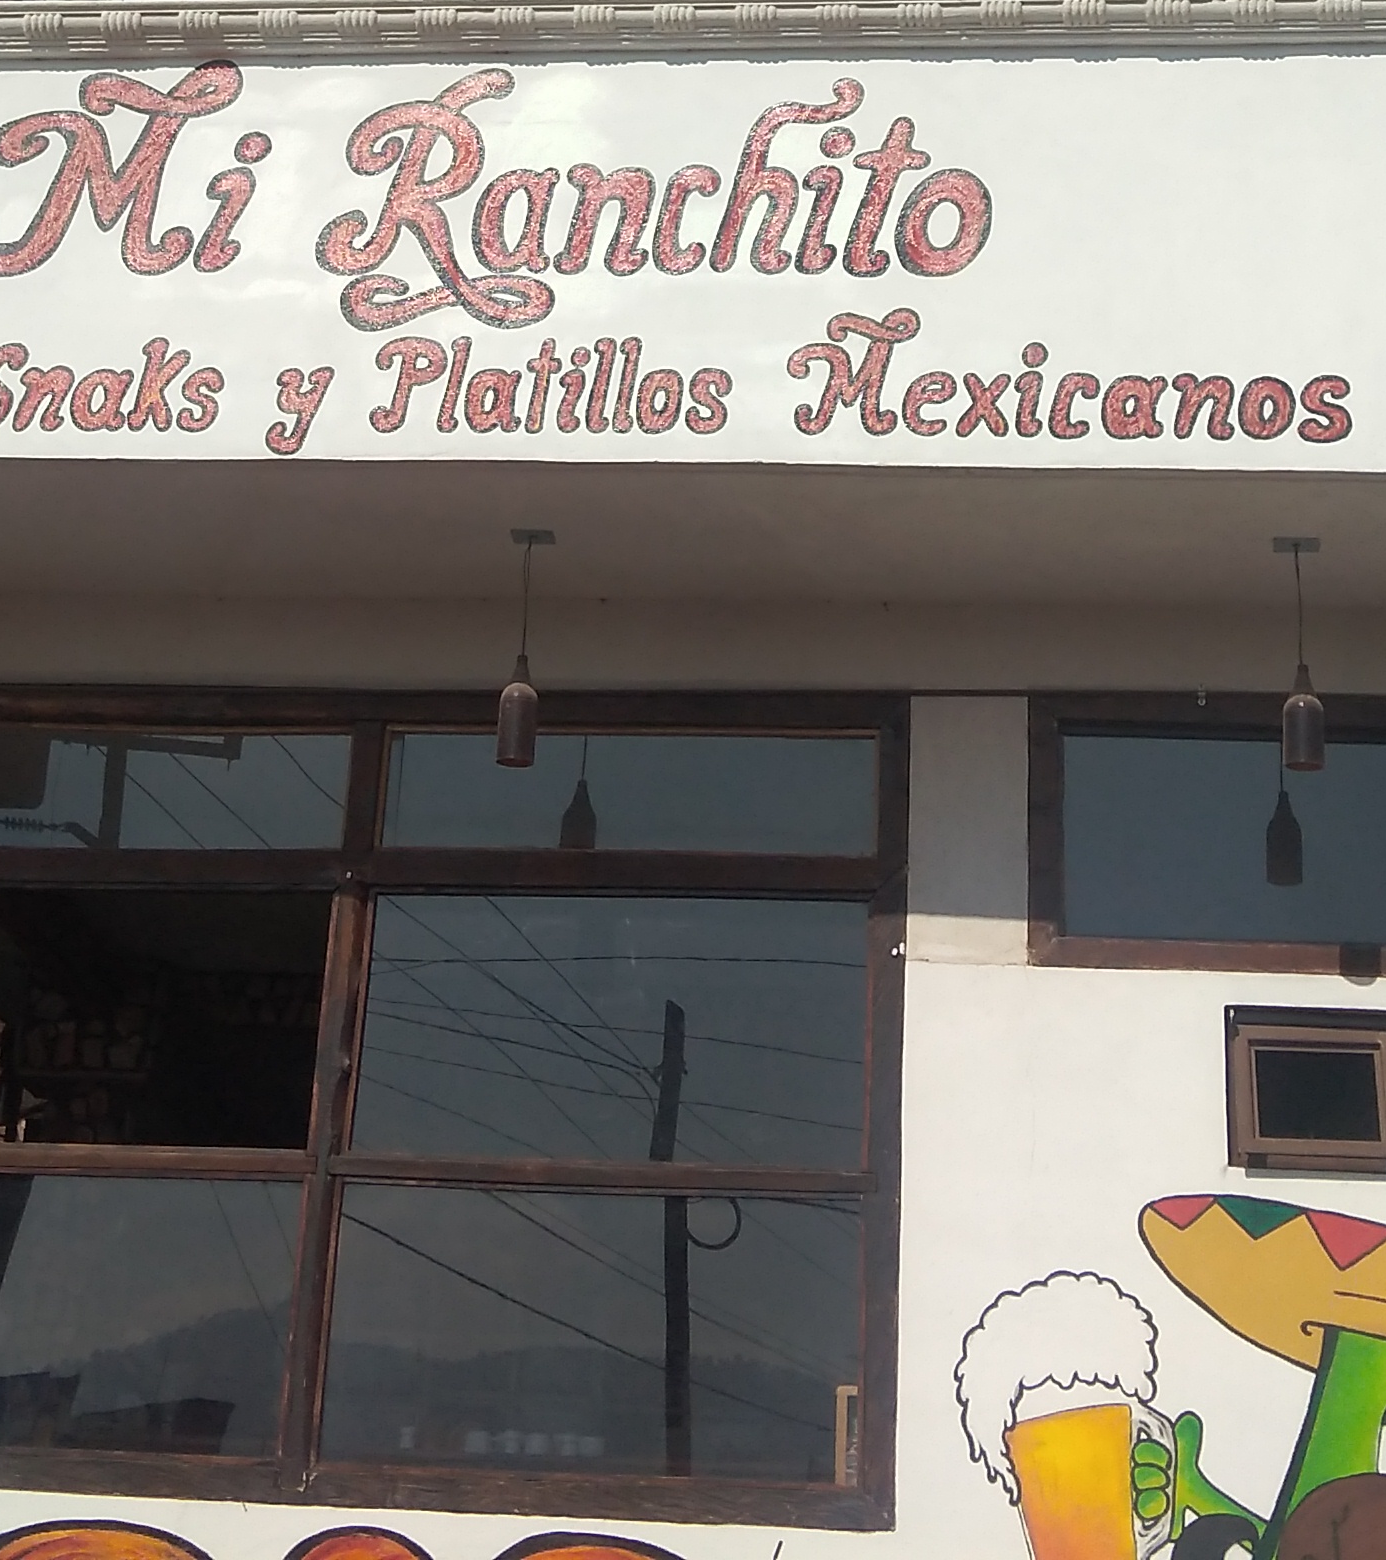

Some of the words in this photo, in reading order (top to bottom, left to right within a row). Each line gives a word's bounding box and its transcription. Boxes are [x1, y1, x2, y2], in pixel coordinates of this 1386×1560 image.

[315, 68, 993, 331] Ranchito
[264, 366, 336, 455] y
[368, 334, 733, 436] Platillos
[786, 307, 1354, 444] Mexicanos
